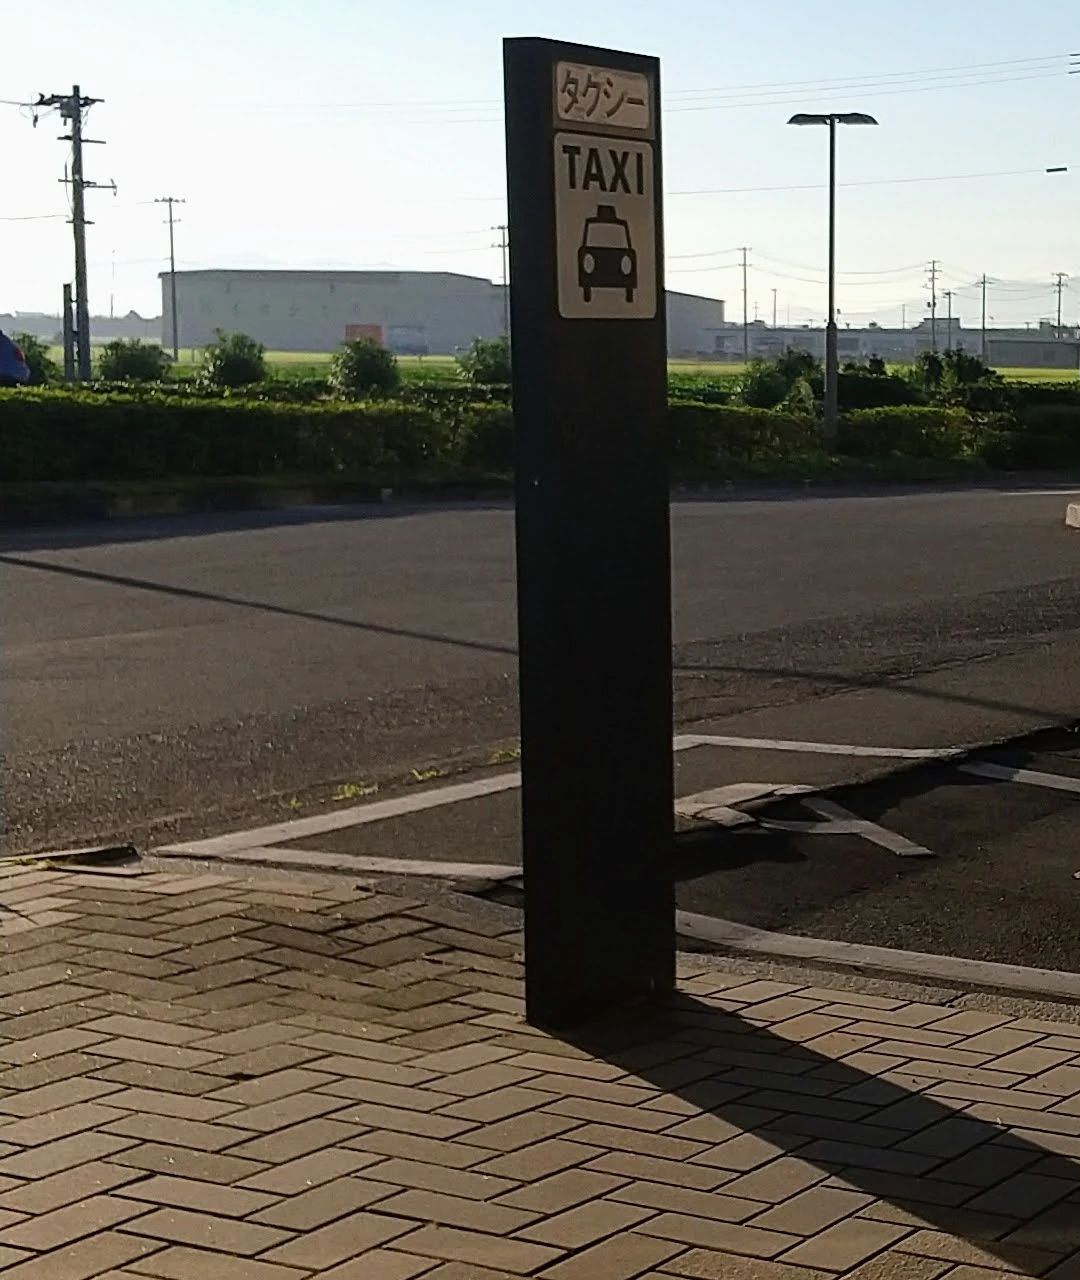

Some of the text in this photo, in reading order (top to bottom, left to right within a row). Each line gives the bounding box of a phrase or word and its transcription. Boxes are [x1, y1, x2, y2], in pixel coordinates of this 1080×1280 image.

[561, 70, 645, 118] タクシー
[562, 145, 644, 195] TAXI
